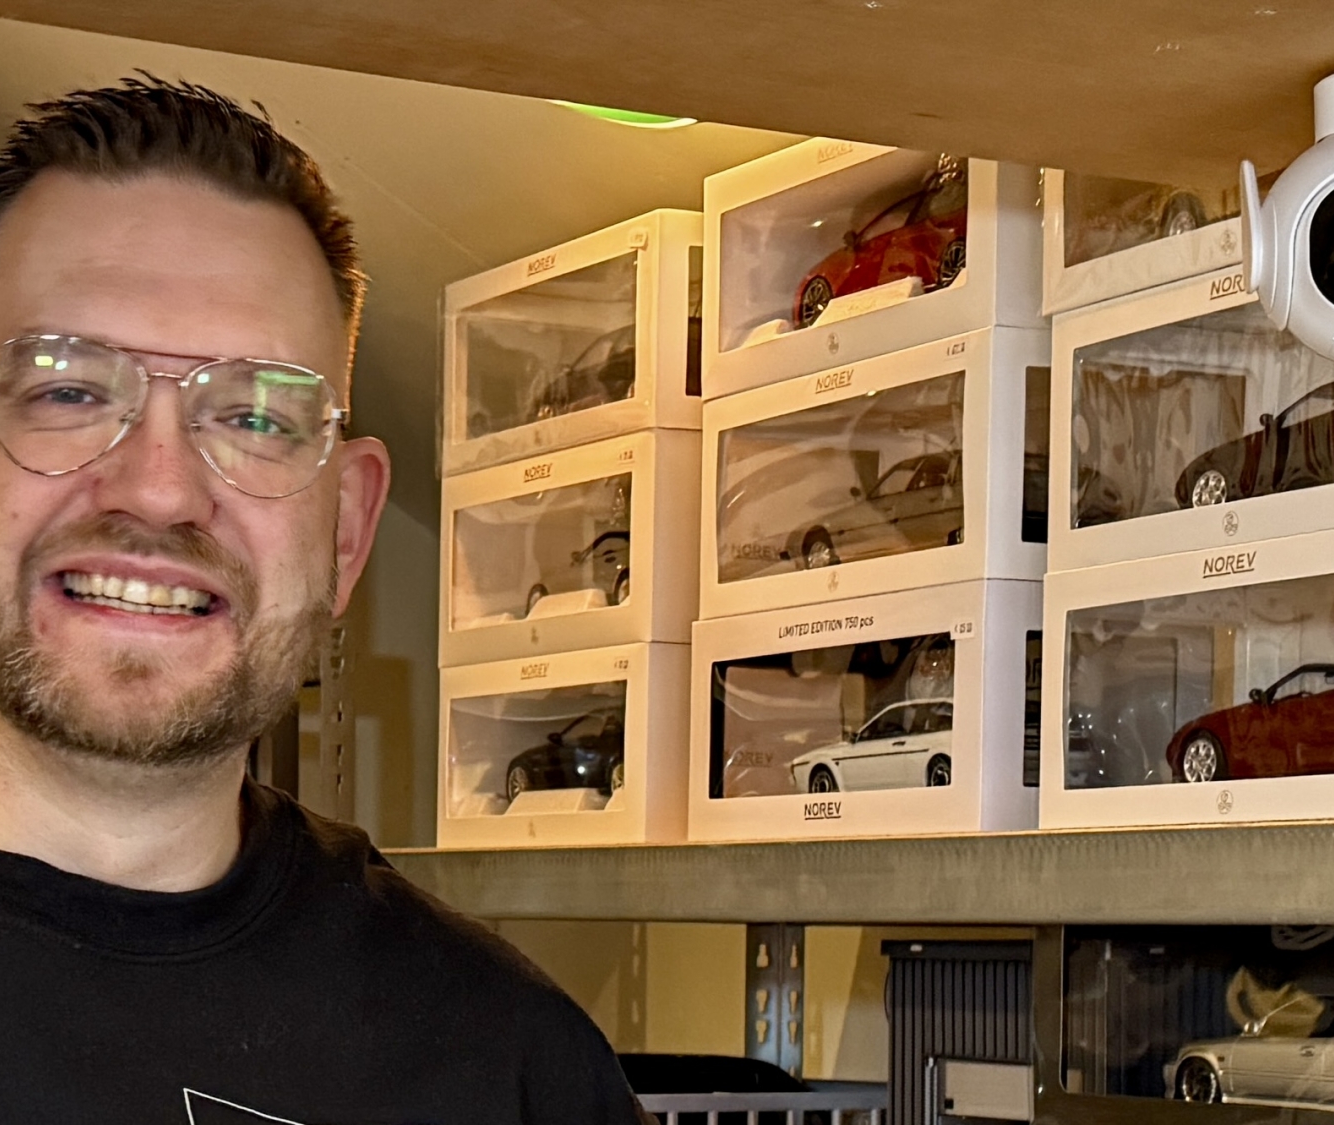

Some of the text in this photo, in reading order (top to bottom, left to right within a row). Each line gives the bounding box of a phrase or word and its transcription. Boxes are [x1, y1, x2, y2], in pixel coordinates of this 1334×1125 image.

[527, 254, 556, 276] NOREV
[1210, 273, 1247, 300] NOR
[815, 368, 854, 393] NOREV
[524, 463, 553, 482] NOREV
[1202, 550, 1256, 578] NOREV
[778, 610, 875, 638] LIMITED EDITION 750 pcs
[520, 662, 549, 680] NOREV
[804, 801, 842, 820] NOREV
